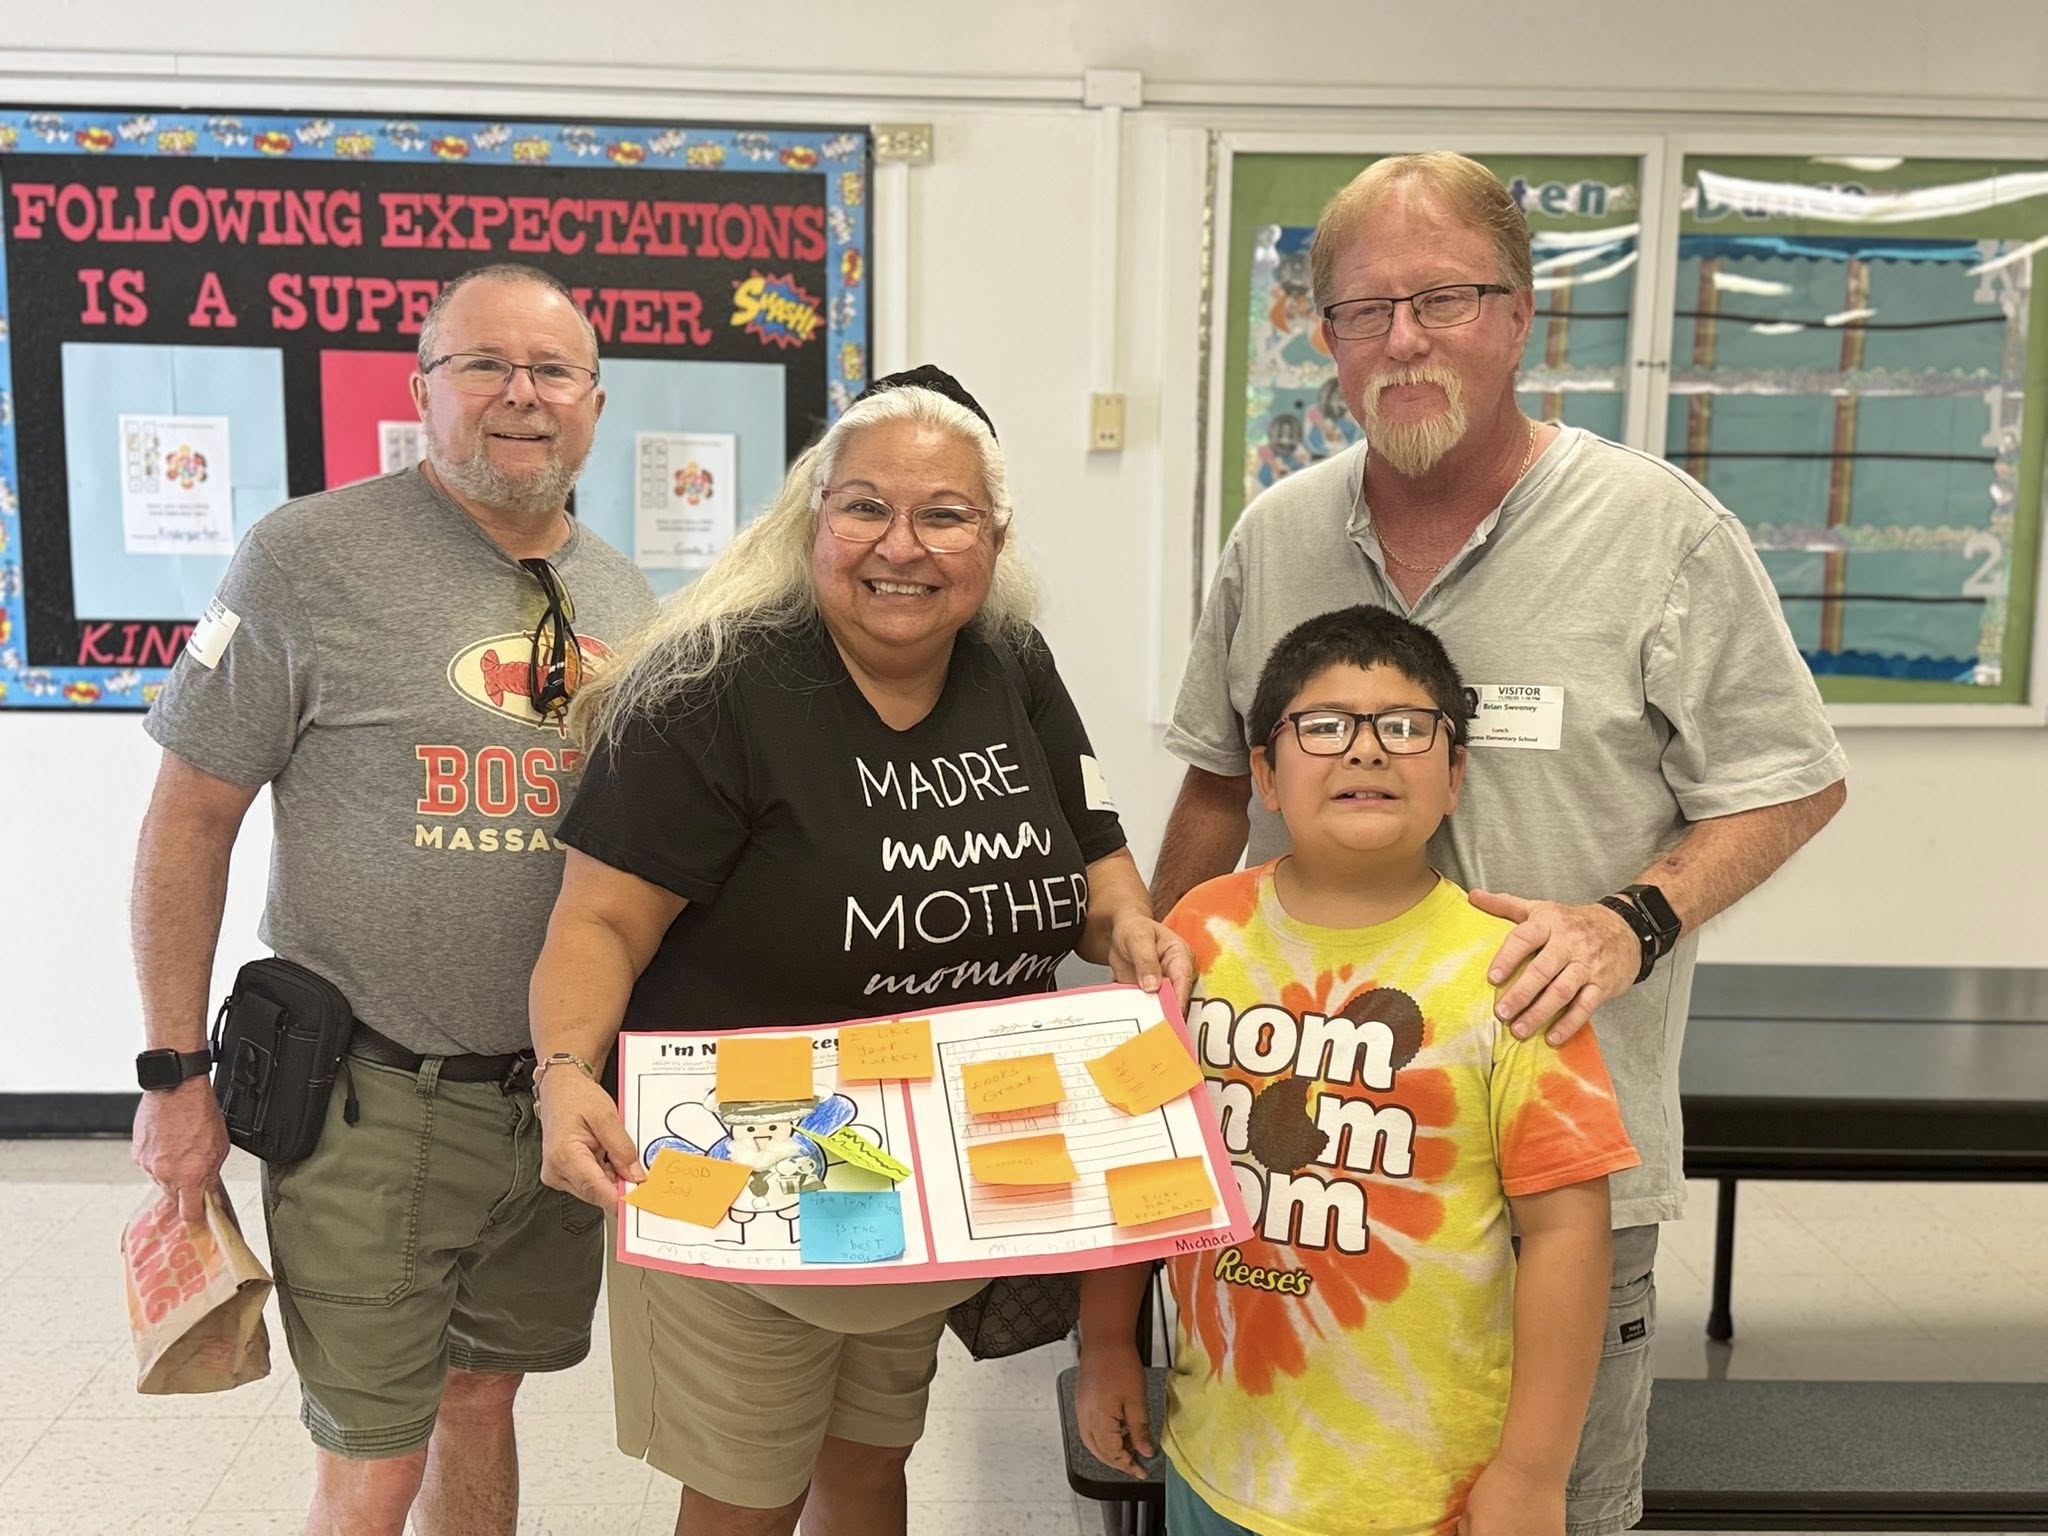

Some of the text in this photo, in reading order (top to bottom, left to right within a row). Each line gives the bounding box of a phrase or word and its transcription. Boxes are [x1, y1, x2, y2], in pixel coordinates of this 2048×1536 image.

[11, 183, 827, 261] FOLLOWING EXPECTATIONS
[78, 269, 149, 327] IS
[188, 272, 237, 328] A
[1483, 703, 1502, 711] Brian
[1498, 686, 1541, 696] VISITOR
[856, 743, 1029, 810] MADRE
[415, 825, 567, 852] MASSA
[882, 821, 1050, 872] mama
[844, 873, 1088, 951] MOTHER
[661, 1043, 694, 1057] I'm
[1174, 1230, 1235, 1252] Michael
[1216, 1249, 1311, 1294] Reese's
